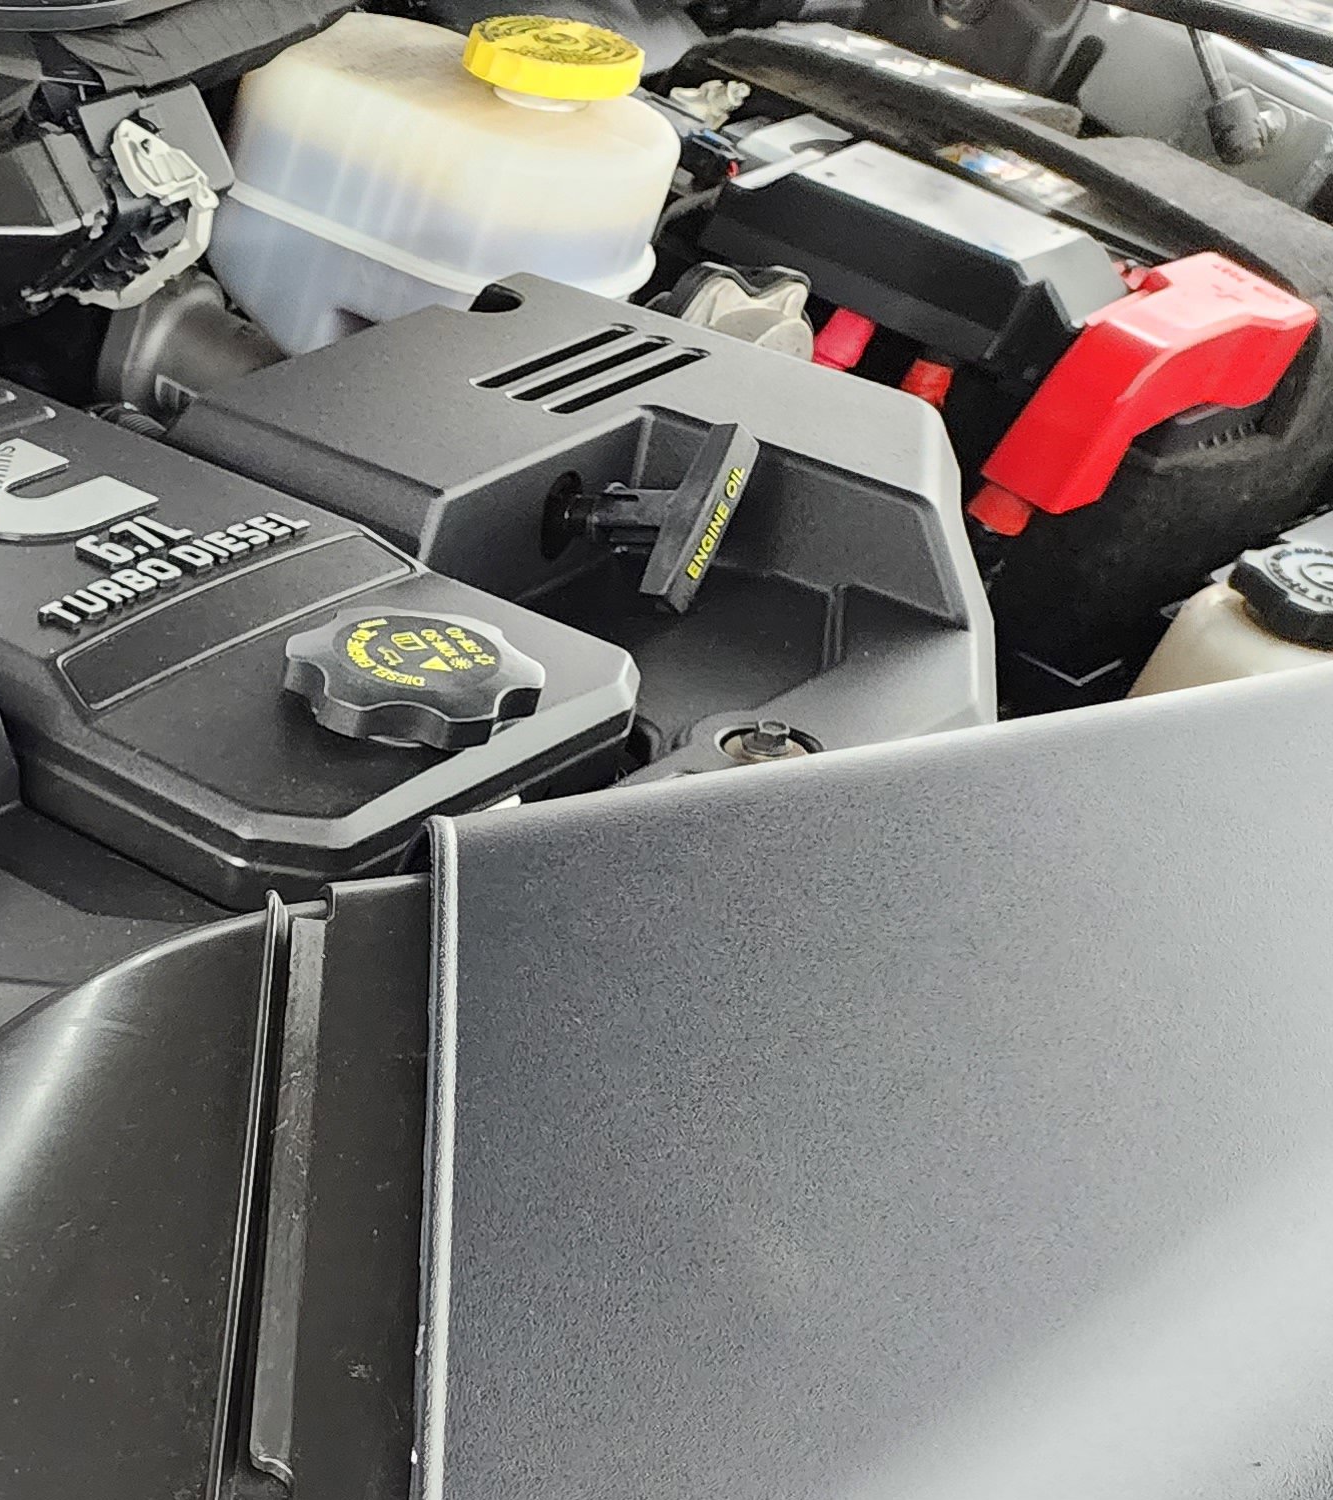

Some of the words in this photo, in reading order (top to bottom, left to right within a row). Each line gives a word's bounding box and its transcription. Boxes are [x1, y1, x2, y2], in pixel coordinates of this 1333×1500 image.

[76, 515, 194, 567] 6.7L
[686, 500, 730, 579] ENGINE
[725, 467, 745, 498] OIL
[38, 557, 183, 627] TURBO
[168, 512, 311, 570] DIESEL
[371, 664, 426, 687] DIESEL
